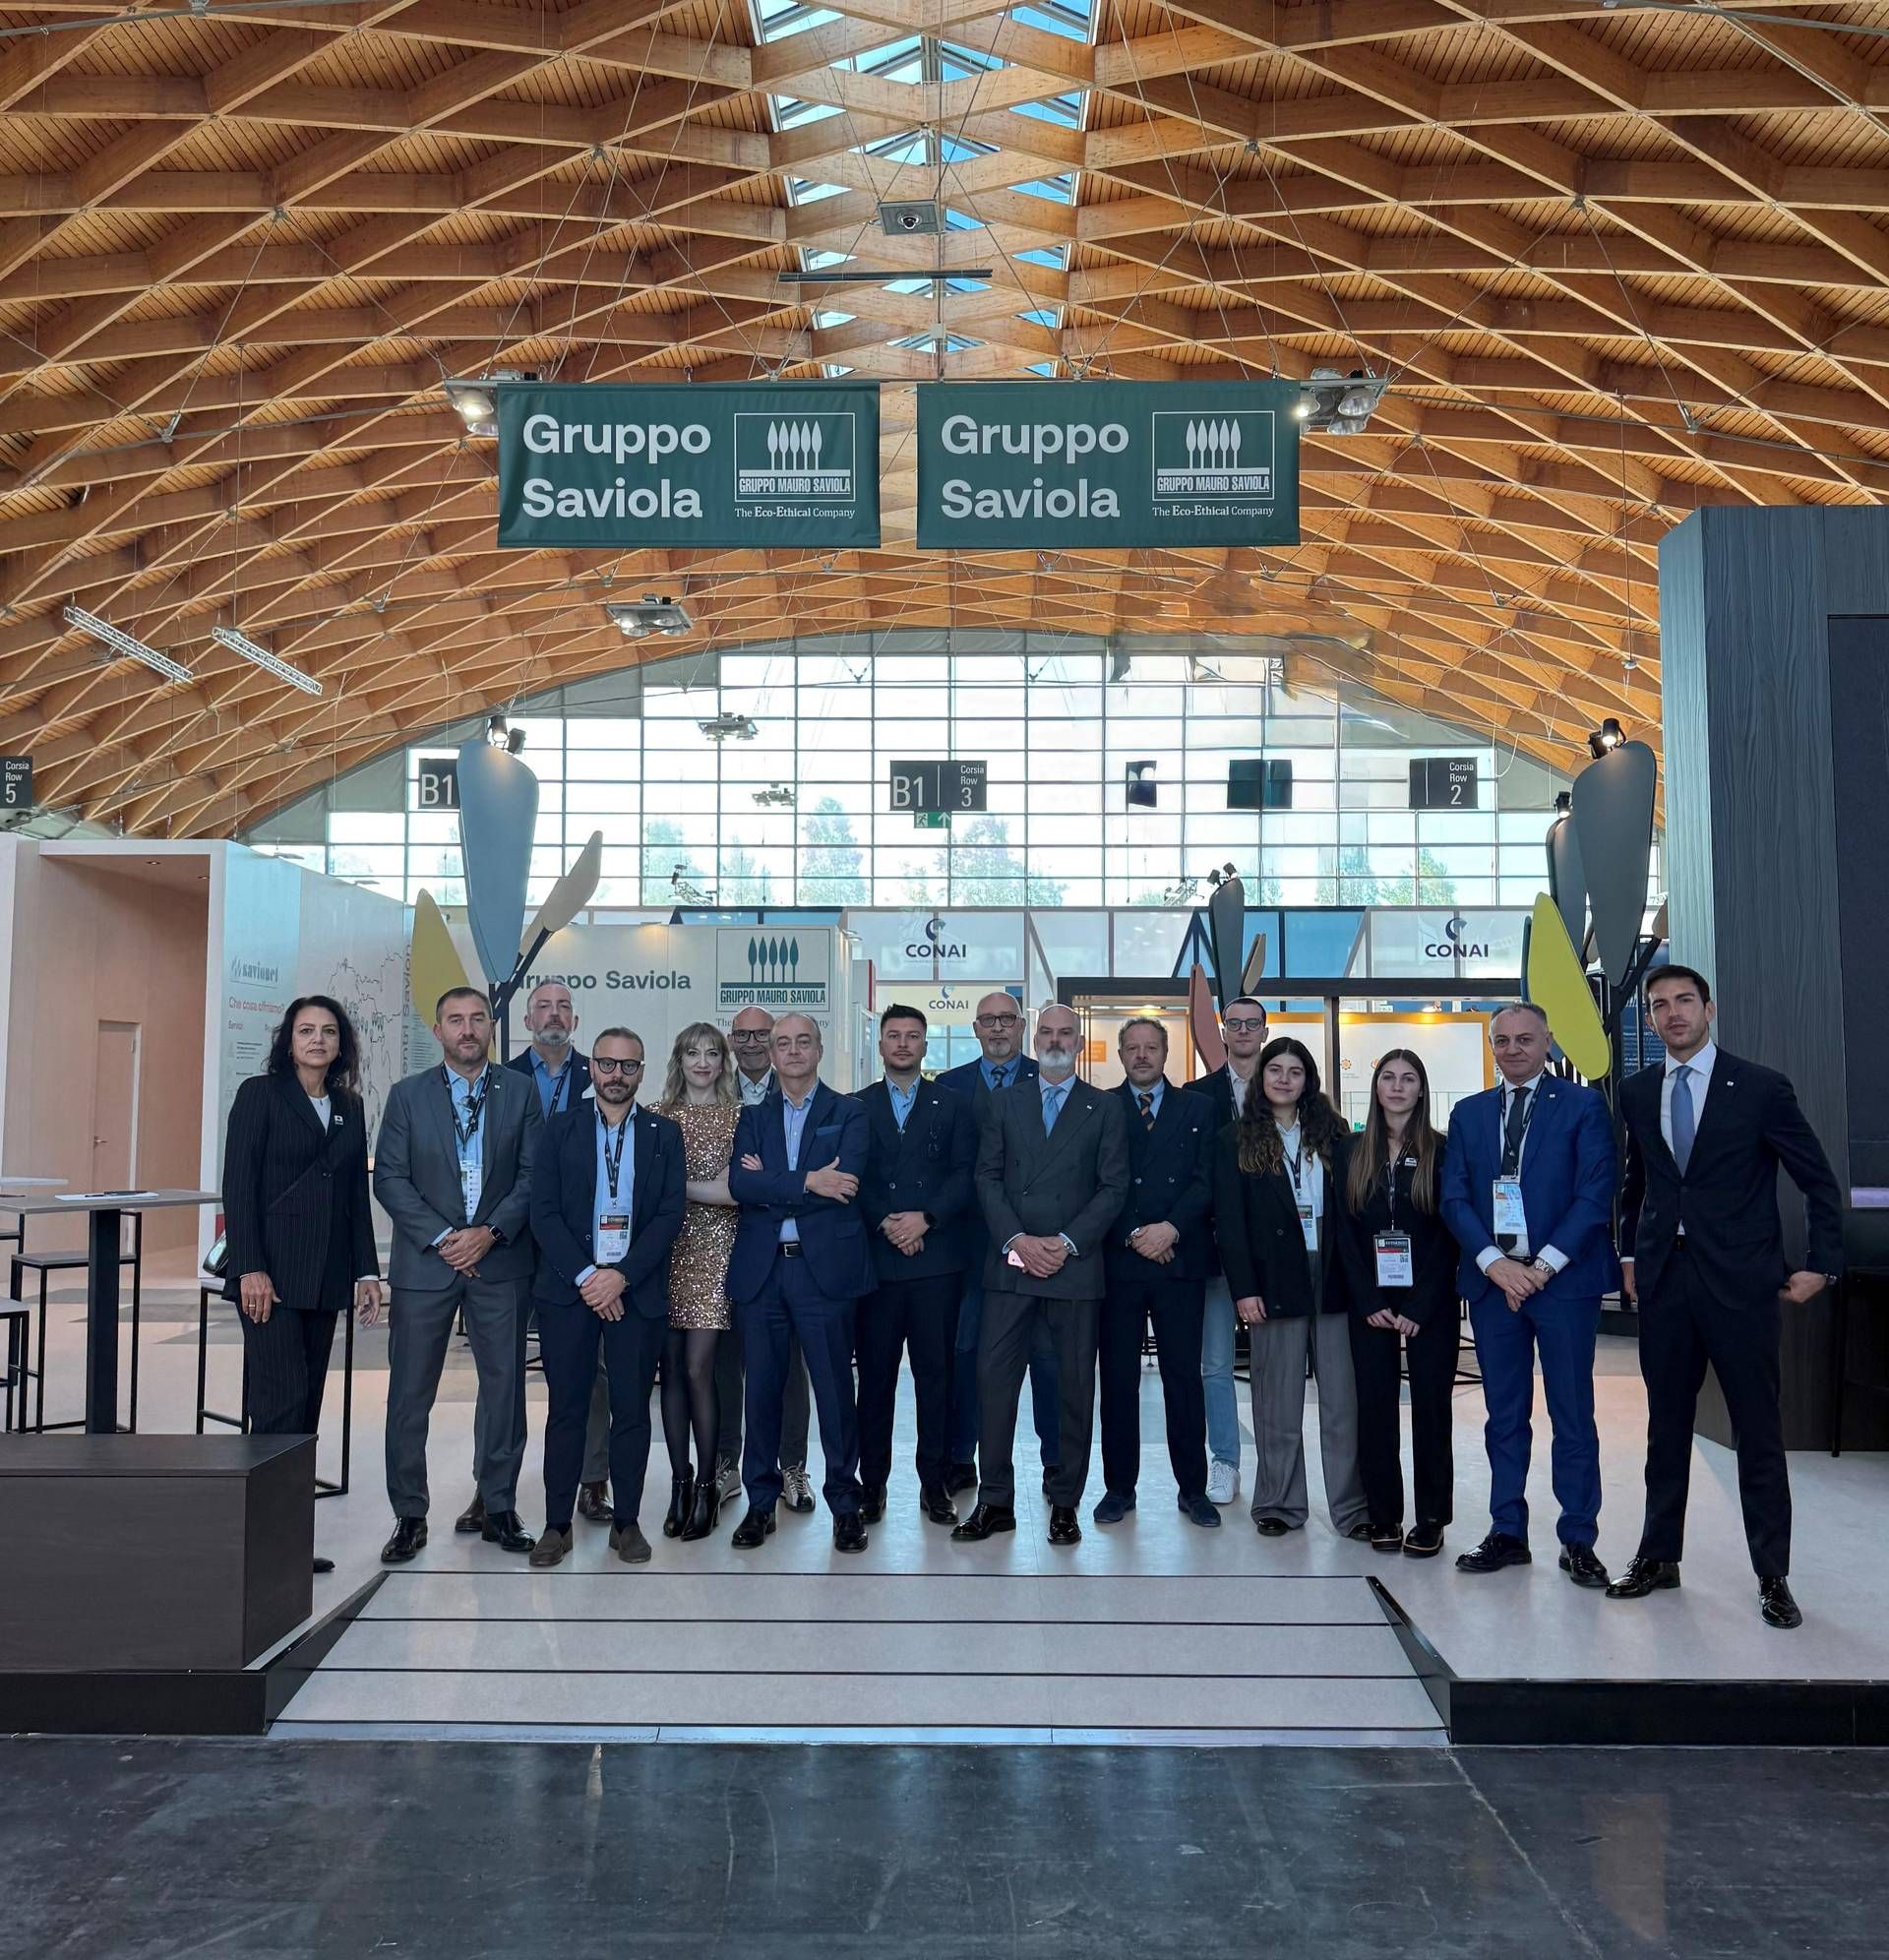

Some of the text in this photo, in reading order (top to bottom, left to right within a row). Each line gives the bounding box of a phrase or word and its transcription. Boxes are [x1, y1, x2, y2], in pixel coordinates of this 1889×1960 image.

[522, 413, 712, 464] Gruppo
[941, 414, 1129, 464] Gruppo
[739, 477, 851, 493] GRUPPO MAURO SAVIOLA
[1157, 475, 1270, 492] GRUPPO MAURO SAVIOLA
[522, 477, 703, 519] Saviola
[941, 477, 1121, 519] Saviola
[735, 506, 856, 520] The Eco-Ethical Company
[1152, 505, 1275, 518] The Eco-Ethical Company
[5, 761, 30, 770] Corsia
[960, 765, 985, 774] Corsia
[1449, 762, 1474, 771] Corsia
[5, 771, 23, 781] Row
[960, 775, 978, 785] Row
[1449, 773, 1468, 783] Row
[5, 783, 17, 804] 5
[421, 773, 453, 806] B1
[892, 775, 924, 807] B1
[961, 787, 972, 807] 3
[1450, 784, 1462, 805] 2
[905, 944, 967, 958] CONAI
[1425, 944, 1490, 958] CONAI
[520, 969, 692, 990] ruppo Saviola
[720, 989, 826, 1004] GRUPPO MAURO SAVIOLA
[929, 1000, 969, 1010] CONAI
[716, 1017, 732, 1027] The
